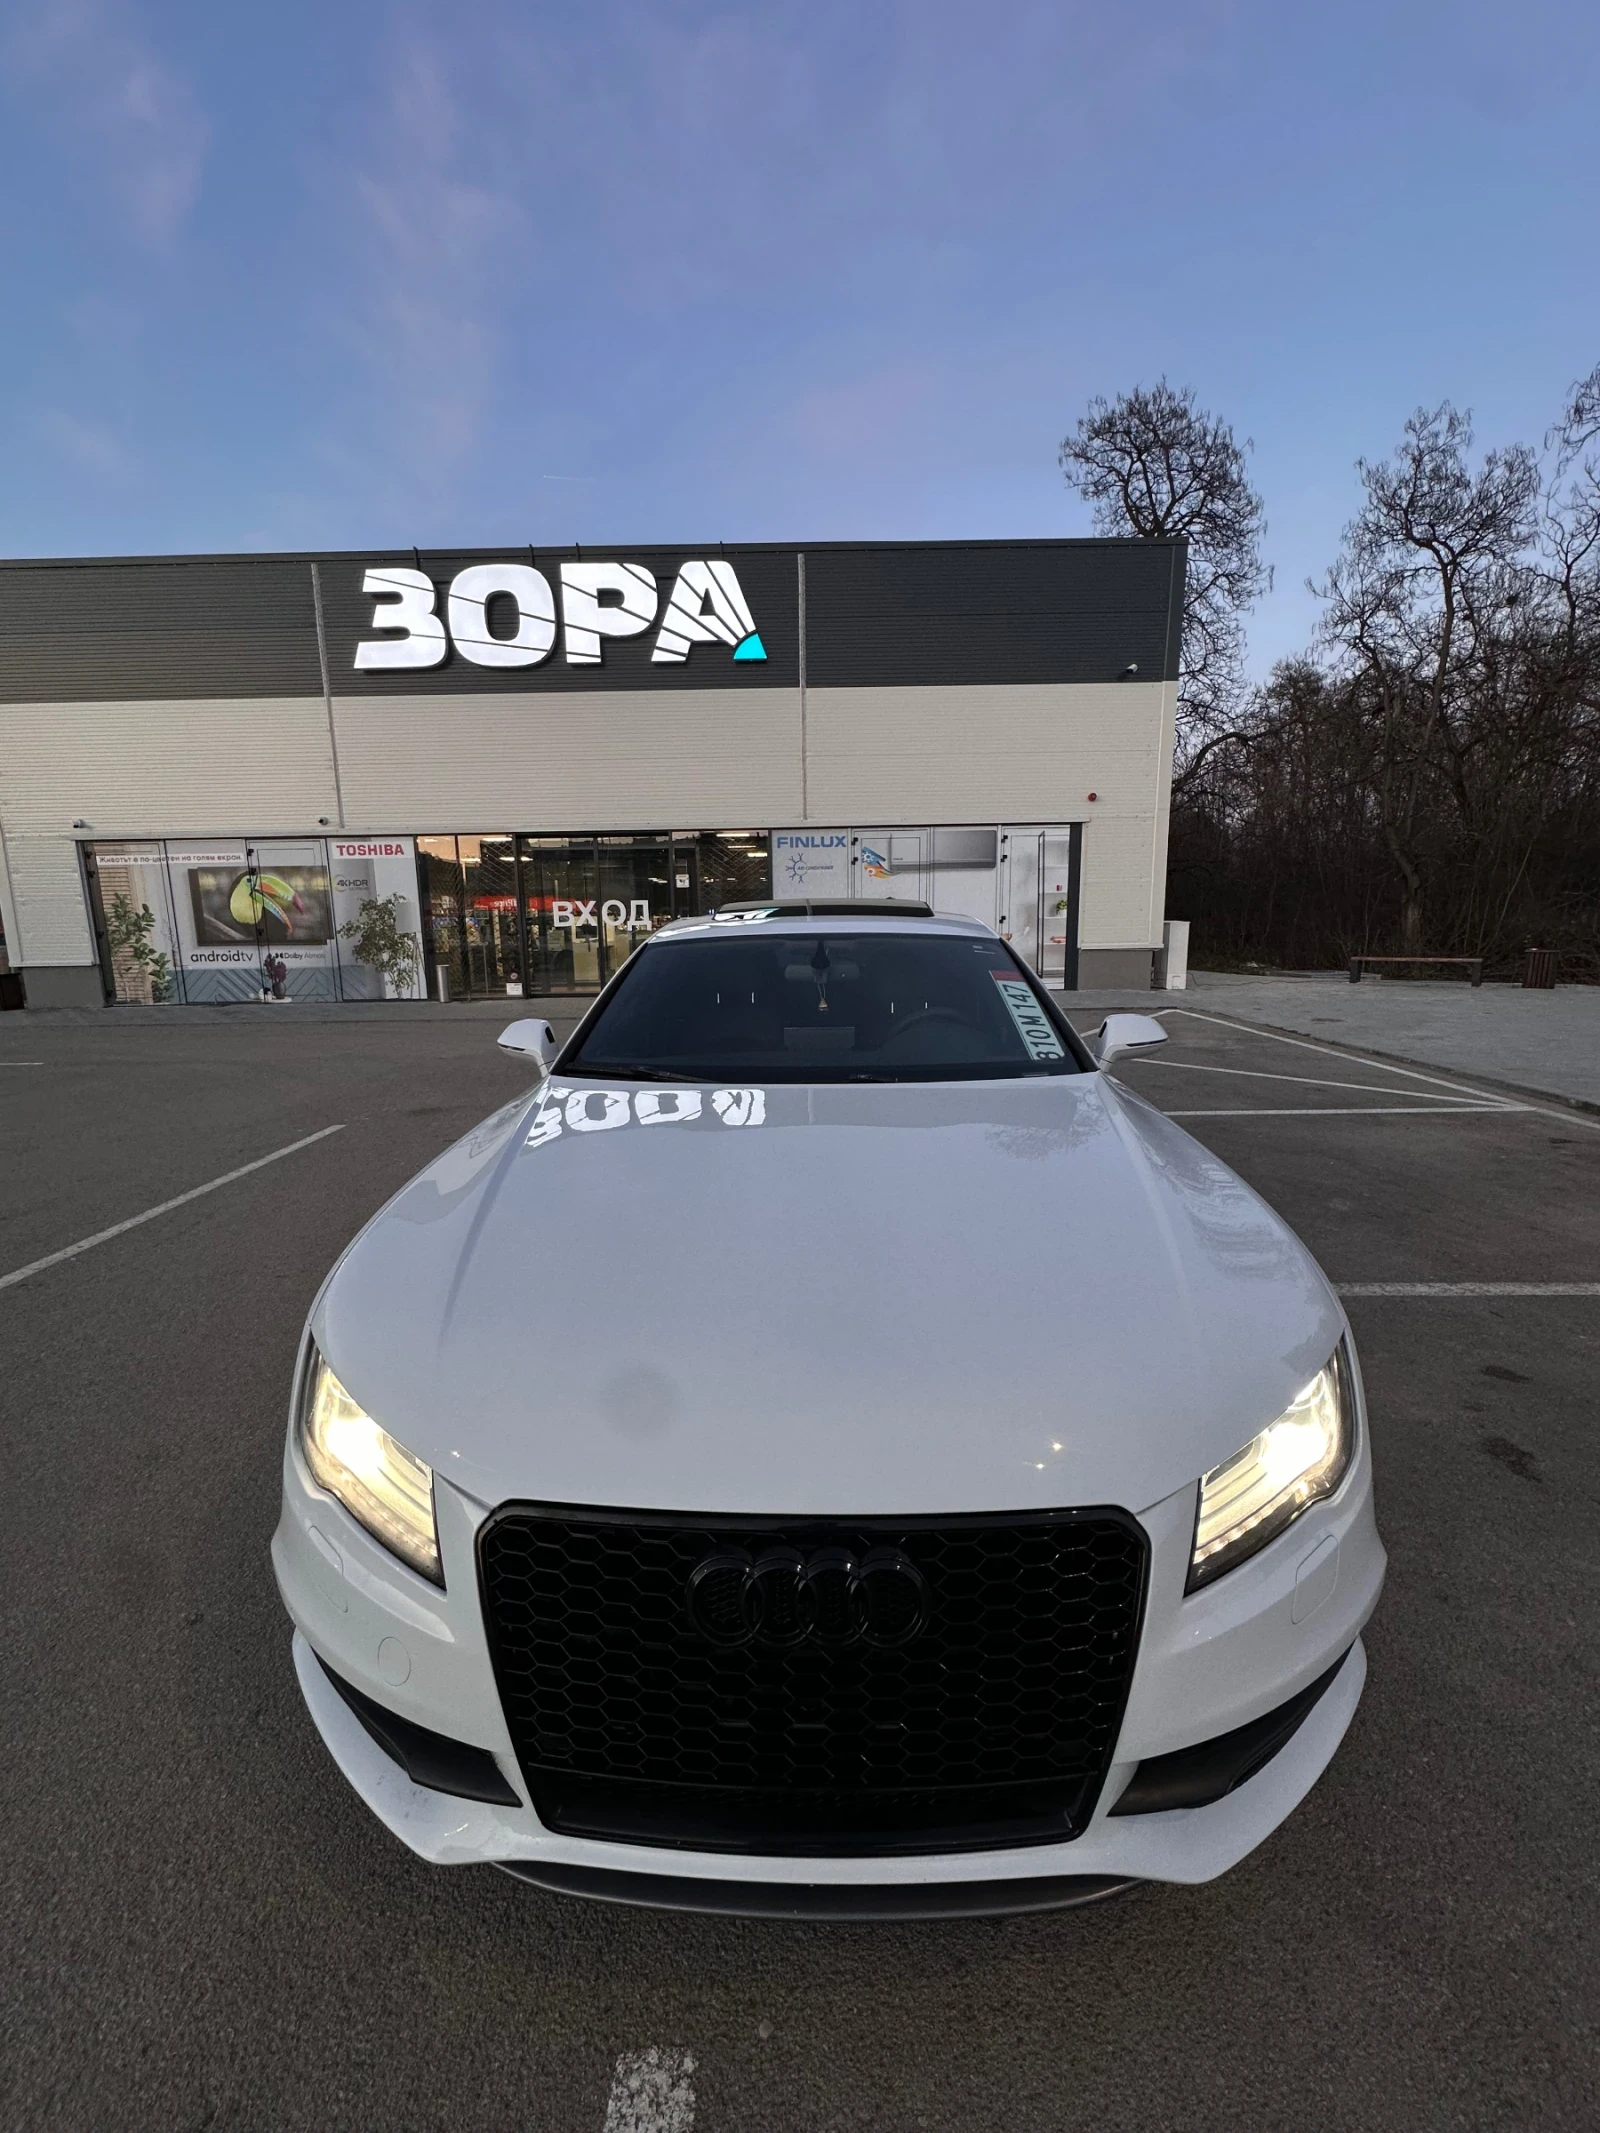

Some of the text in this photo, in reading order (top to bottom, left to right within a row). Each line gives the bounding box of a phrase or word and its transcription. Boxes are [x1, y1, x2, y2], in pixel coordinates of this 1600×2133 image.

[353, 561, 768, 669] ЗОРА
[777, 836, 847, 848] FINLUX
[336, 844, 404, 856] TOSHIBA
[552, 900, 651, 931] ВХОД
[284, 952, 303, 960] Dolby
